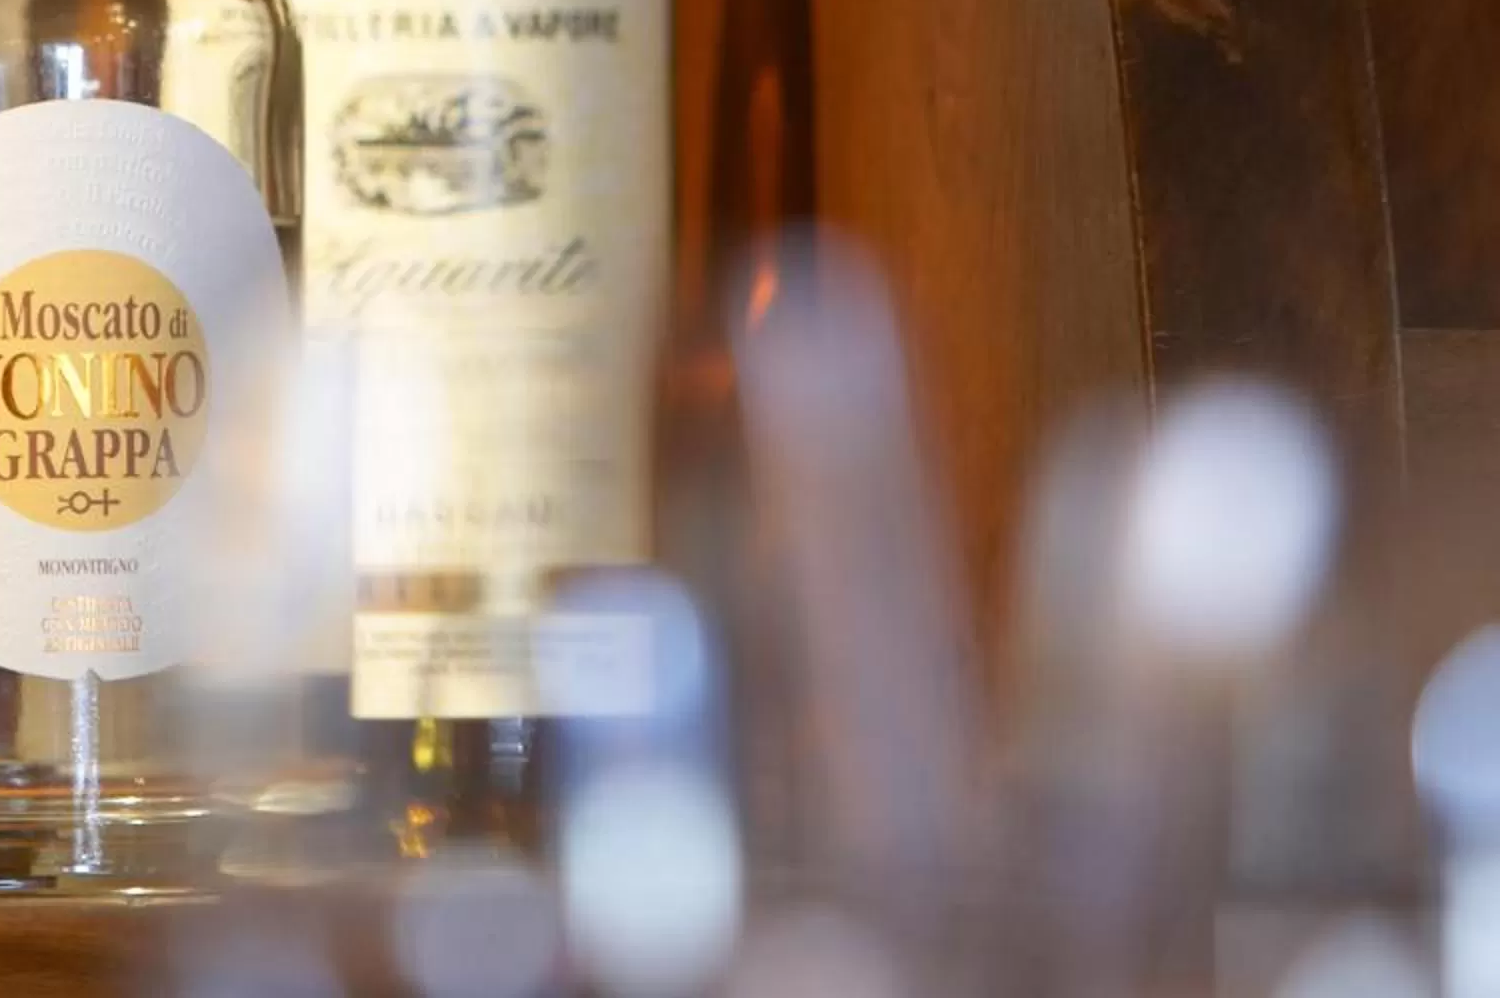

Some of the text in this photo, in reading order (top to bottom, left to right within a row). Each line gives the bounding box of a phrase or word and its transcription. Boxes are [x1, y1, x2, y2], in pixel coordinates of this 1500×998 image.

[0, 290, 161, 341] Moscato
[169, 308, 189, 339] di
[38, 558, 139, 576] MONOVITIGNO
